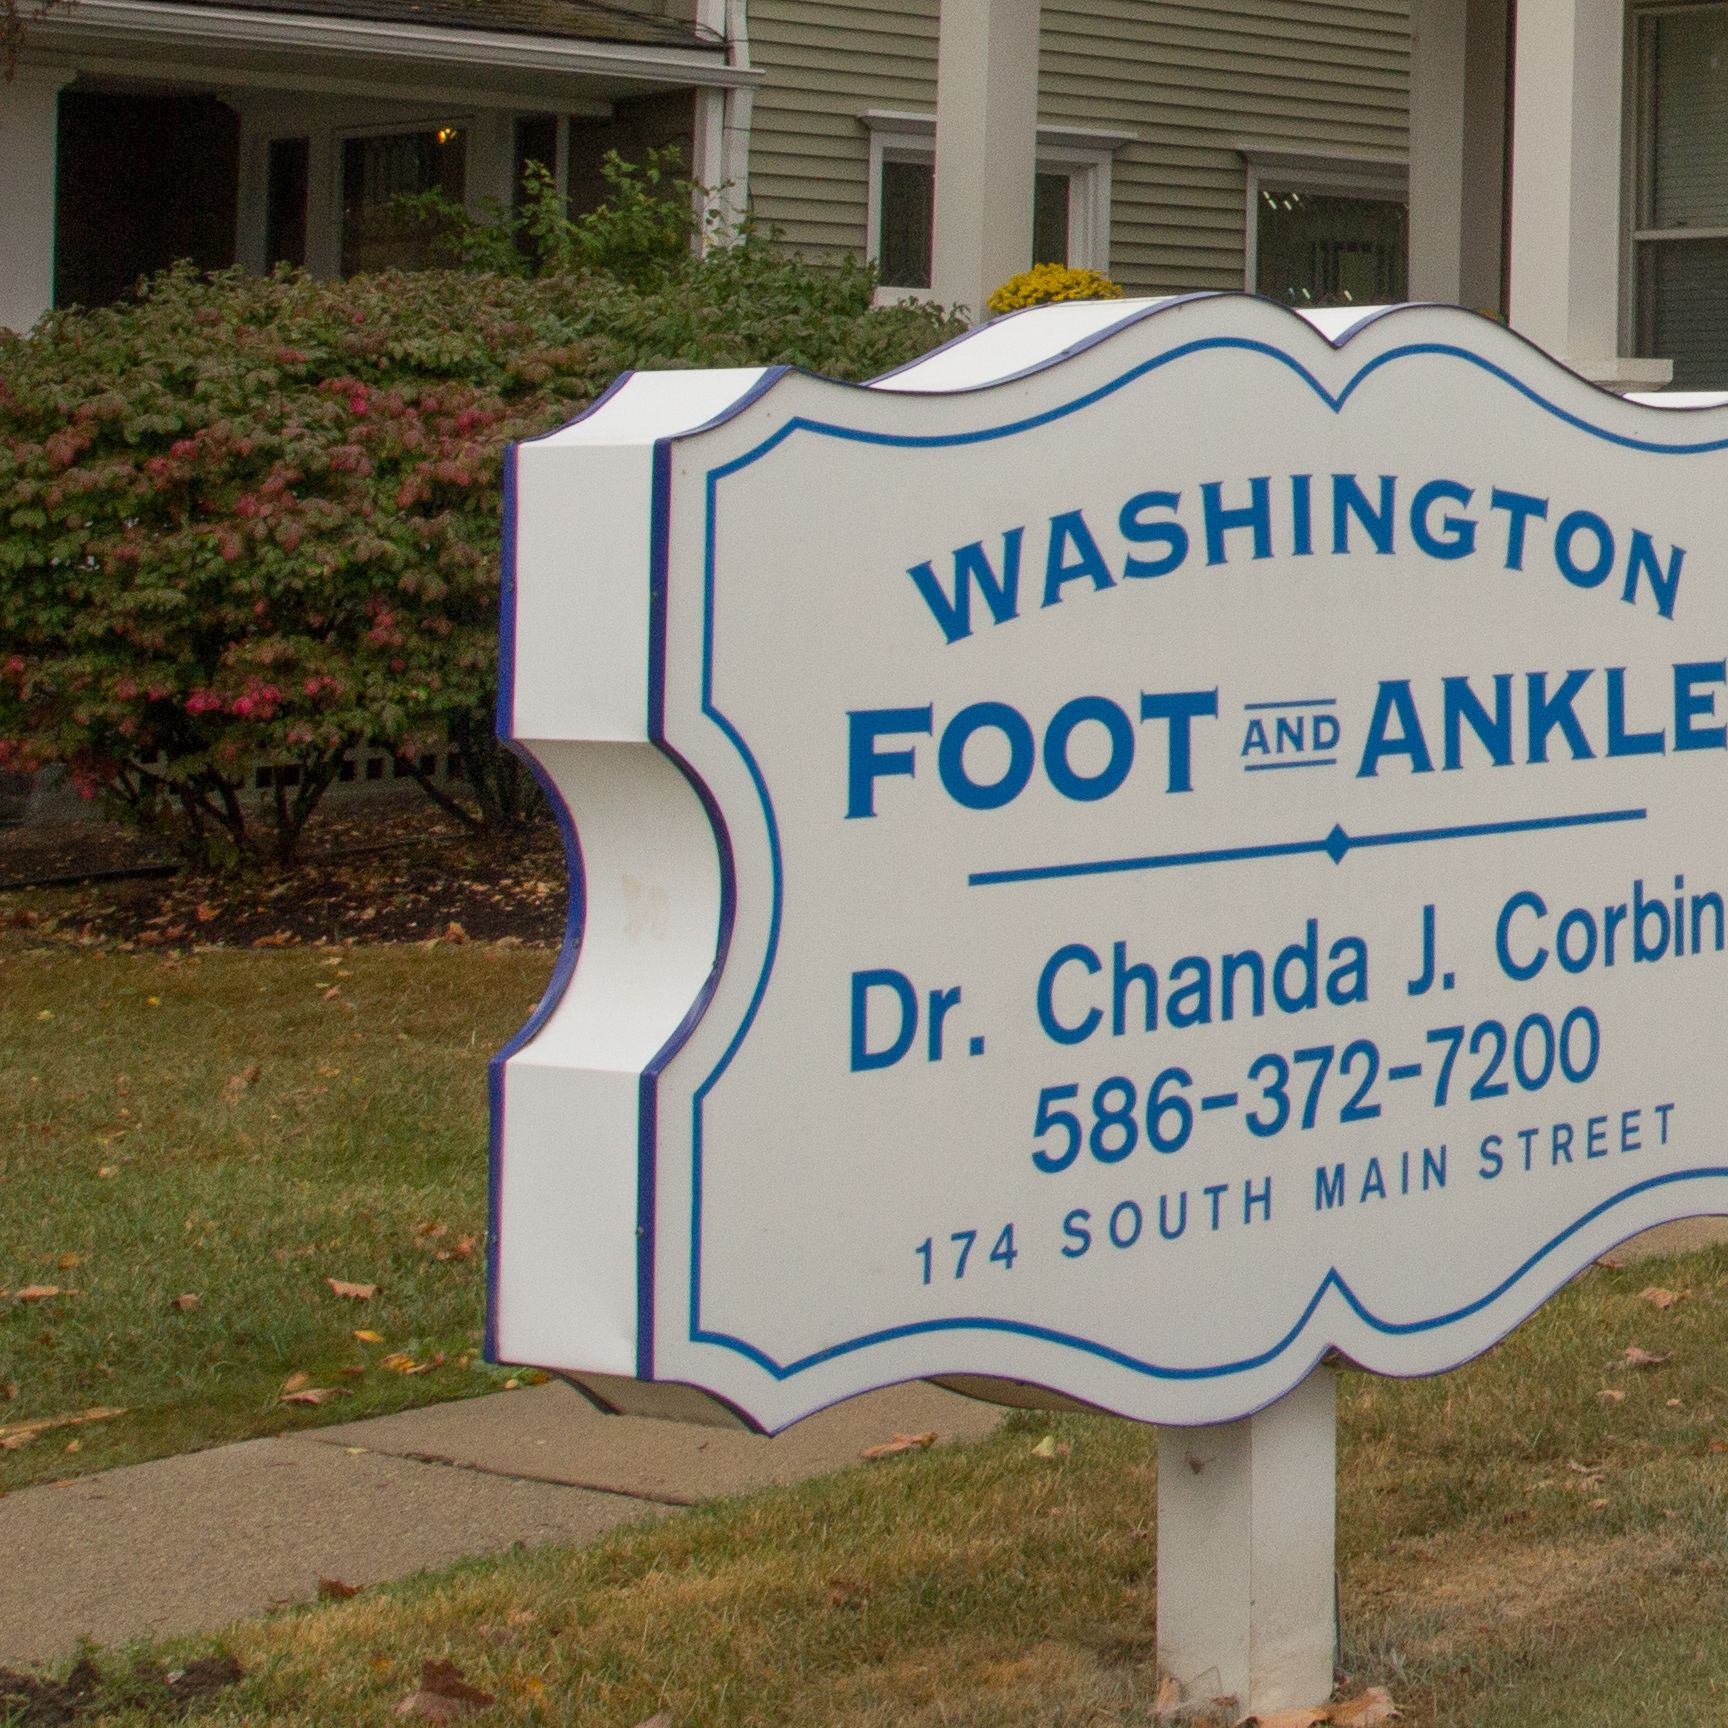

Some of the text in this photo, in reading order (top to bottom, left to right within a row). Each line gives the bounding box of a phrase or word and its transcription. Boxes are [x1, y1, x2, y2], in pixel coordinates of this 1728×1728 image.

[906, 473, 1686, 646] WASHINGTON
[844, 659, 1728, 821] FOOT AND ANKLE
[848, 874, 1725, 1074] Dr. Chanda J. Corbin
[1030, 1005, 1601, 1176] 586-372-7200
[914, 1102, 1679, 1286] 174 SOUTH MAIN STREET
